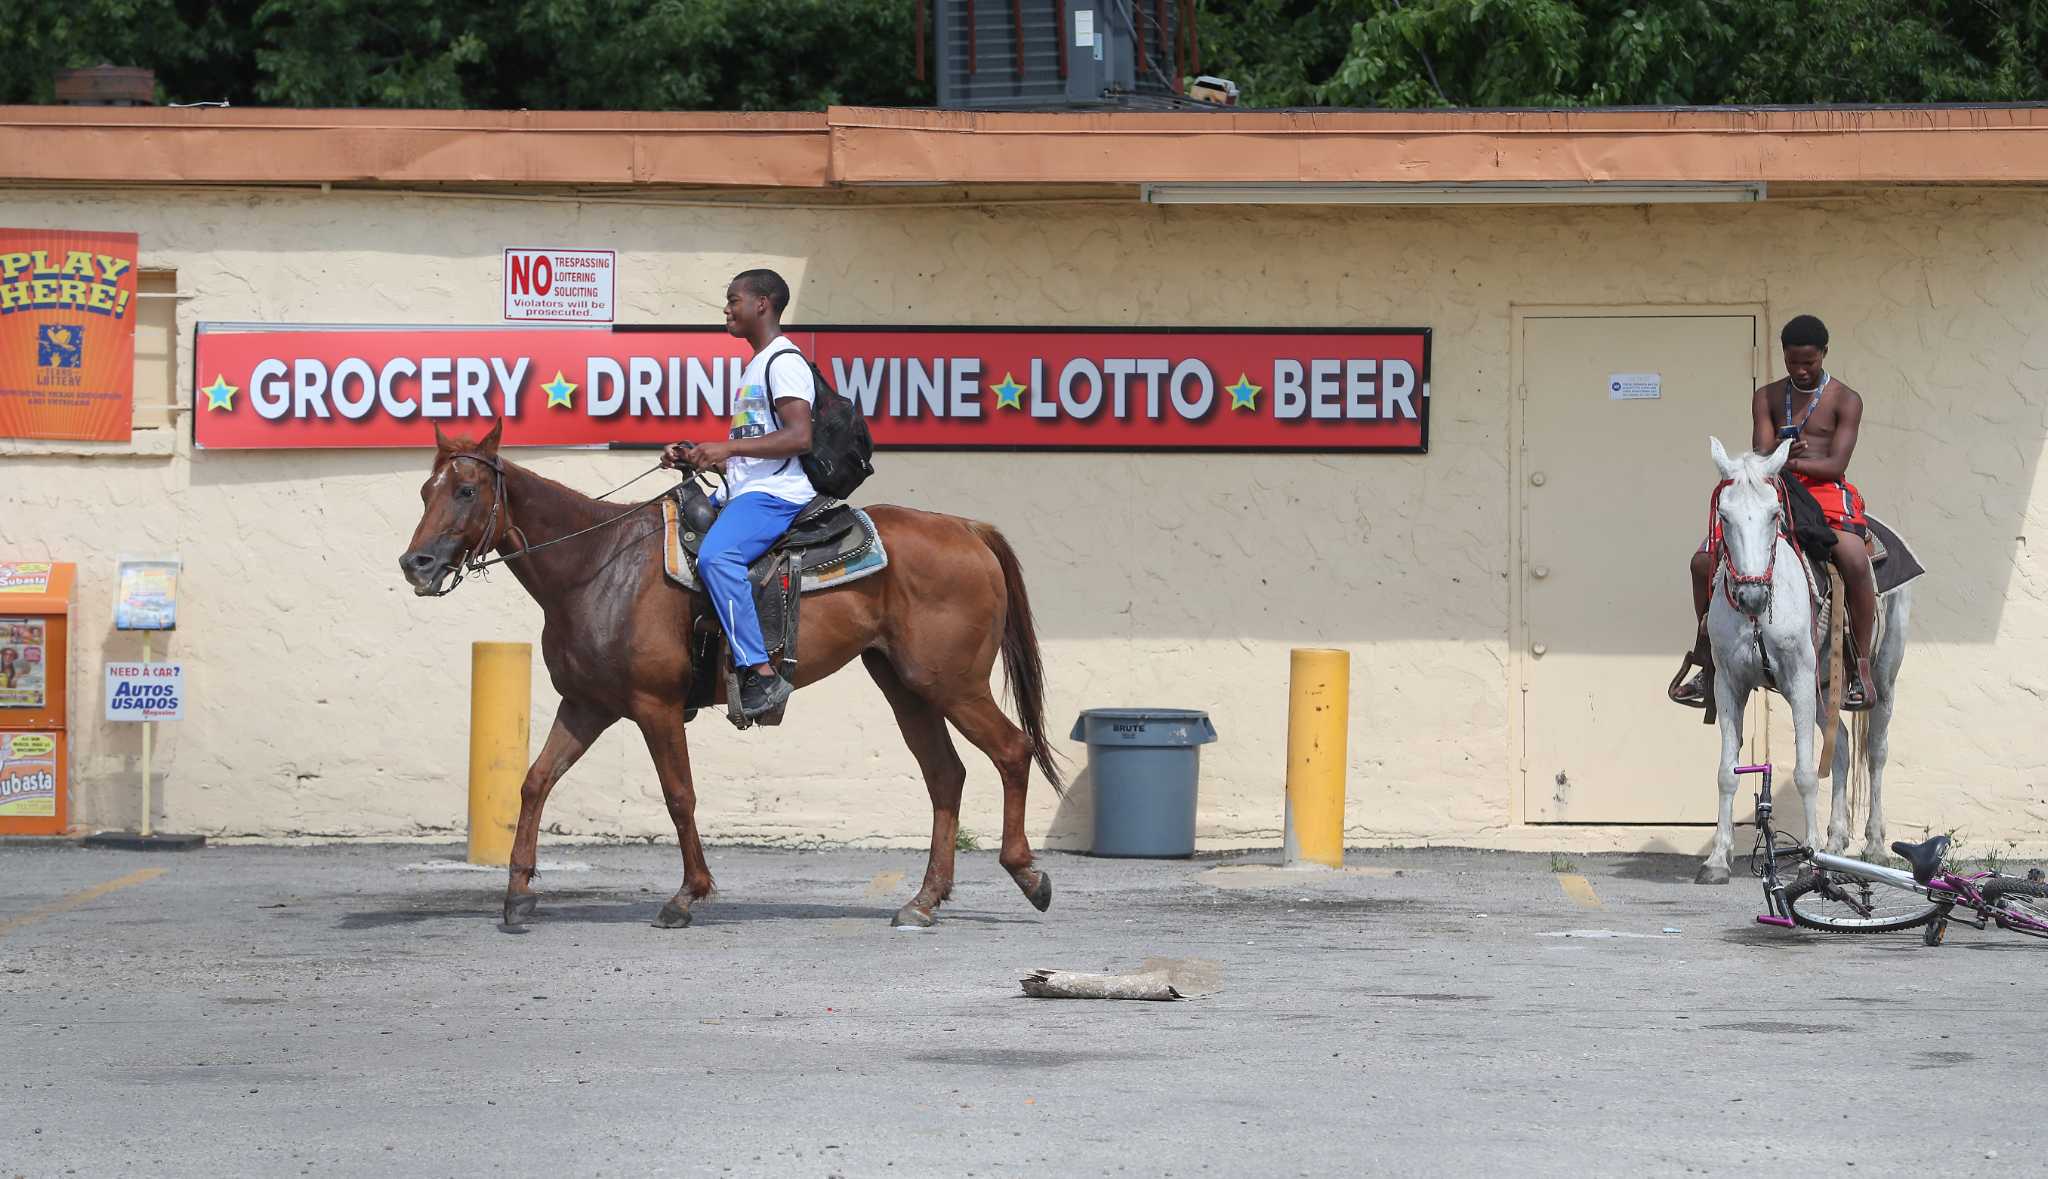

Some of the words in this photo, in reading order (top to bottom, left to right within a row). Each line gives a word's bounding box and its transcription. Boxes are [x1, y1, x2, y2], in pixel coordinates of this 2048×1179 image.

[0, 251, 130, 285] PLAY
[511, 255, 552, 296] NO
[555, 257, 609, 268] TRESPASSING
[555, 272, 596, 283] LOITERING
[0, 280, 129, 317] HERE!
[554, 287, 598, 298] SOLICITING
[514, 299, 564, 308] Violators
[567, 300, 588, 308] will
[591, 301, 605, 309] be
[249, 357, 530, 420] GROCERY
[586, 356, 742, 417] DRIN
[831, 357, 981, 417] WINE
[1030, 357, 1214, 419] LOTTO
[1273, 359, 1417, 419] BEER
[110, 667, 139, 677] NEED
[143, 667, 149, 677] A
[153, 666, 180, 677] CAR?
[111, 697, 179, 710] USADOS
[1113, 724, 1145, 732] BRUTE
[0, 770, 52, 795] ubasta
